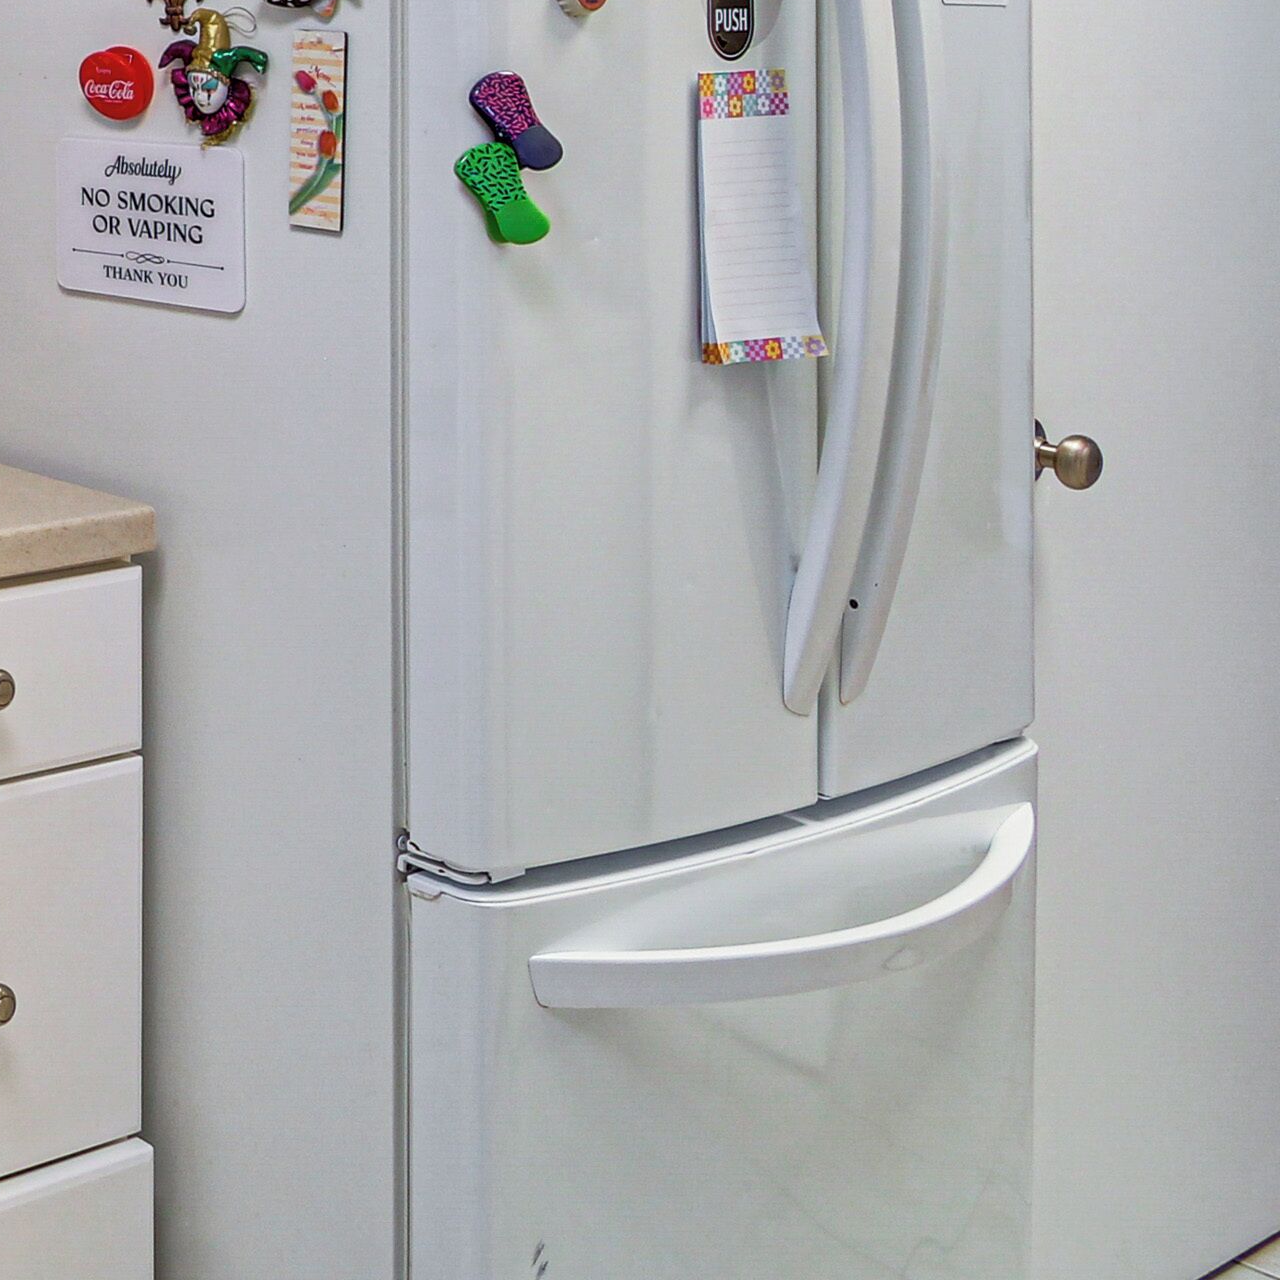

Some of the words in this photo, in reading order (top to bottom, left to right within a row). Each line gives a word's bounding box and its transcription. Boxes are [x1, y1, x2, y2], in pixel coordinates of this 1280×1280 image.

[715, 8, 747, 32] PUSH
[84, 79, 134, 100] Coca-Cola
[104, 155, 182, 186] Absolutely
[81, 187, 111, 208] NO
[117, 190, 215, 218] SMOKING
[92, 214, 121, 236] OR
[128, 218, 203, 245] VAPING
[103, 265, 154, 284] THANK
[158, 272, 189, 289] YOU
